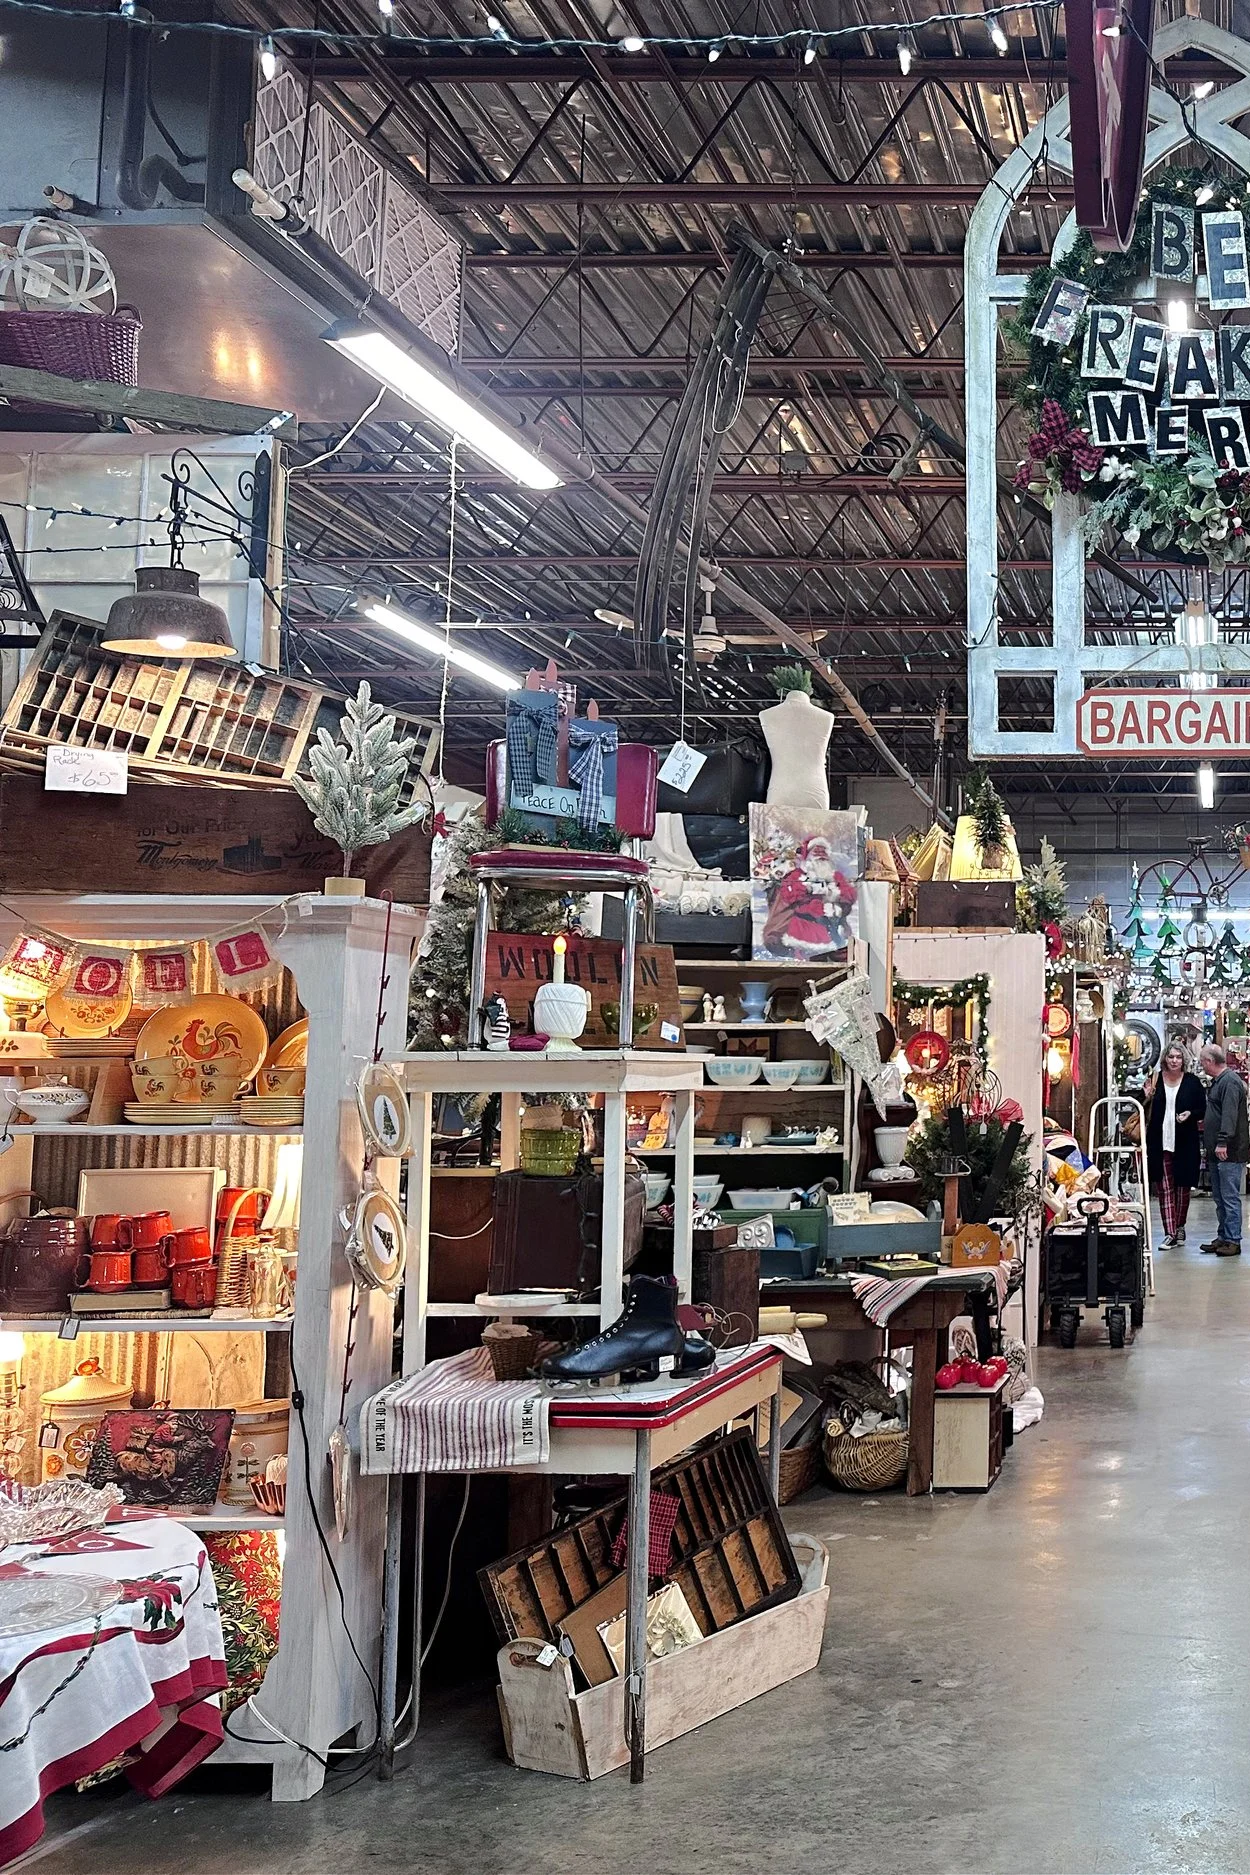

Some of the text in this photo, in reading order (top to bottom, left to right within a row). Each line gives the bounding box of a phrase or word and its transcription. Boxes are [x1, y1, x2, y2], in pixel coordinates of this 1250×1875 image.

[1154, 210, 1247, 302] BE
[63, 748, 95, 761] Drying
[375, 1407, 387, 1416] OF
[375, 1418, 386, 1432] THE
[522, 1399, 535, 1445] IT'S THE MOS
[375, 1433, 386, 1452] YEAR
